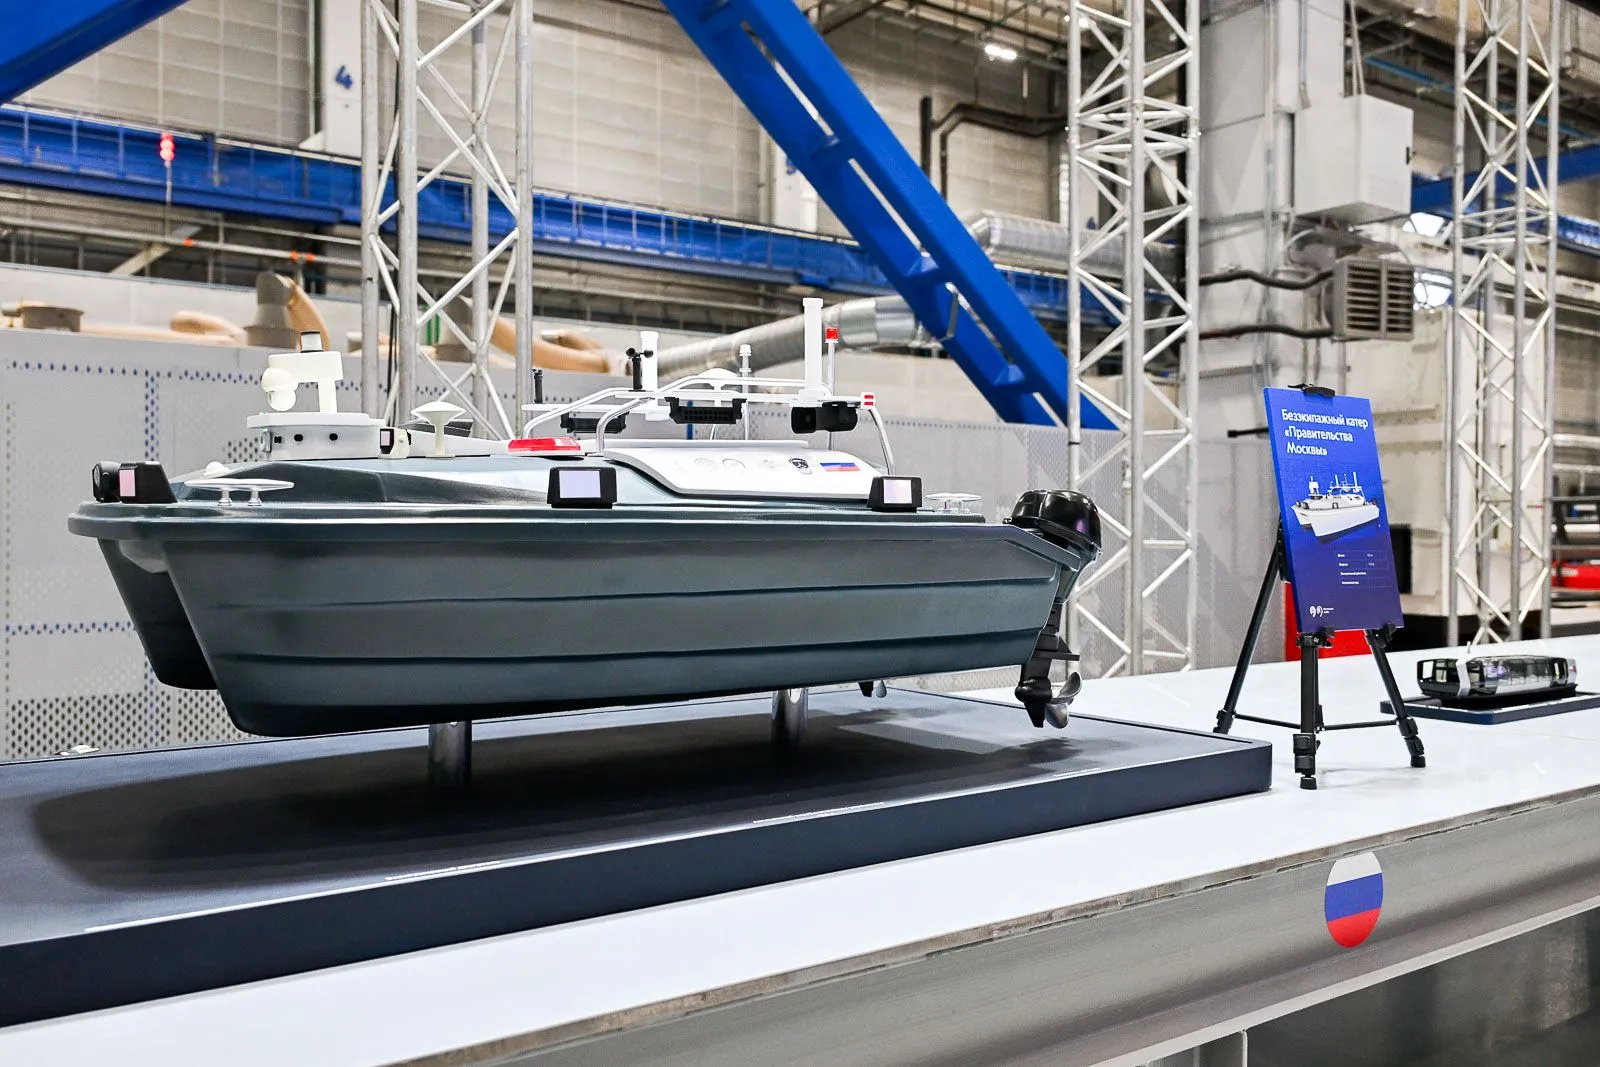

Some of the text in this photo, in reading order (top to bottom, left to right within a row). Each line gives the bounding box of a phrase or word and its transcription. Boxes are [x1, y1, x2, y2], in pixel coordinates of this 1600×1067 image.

[335, 65, 353, 89] 4
[1281, 408, 1369, 430] Безэкипажный катер
[1284, 425, 1353, 442] «Правительства
[1286, 441, 1328, 456] Москвы»
